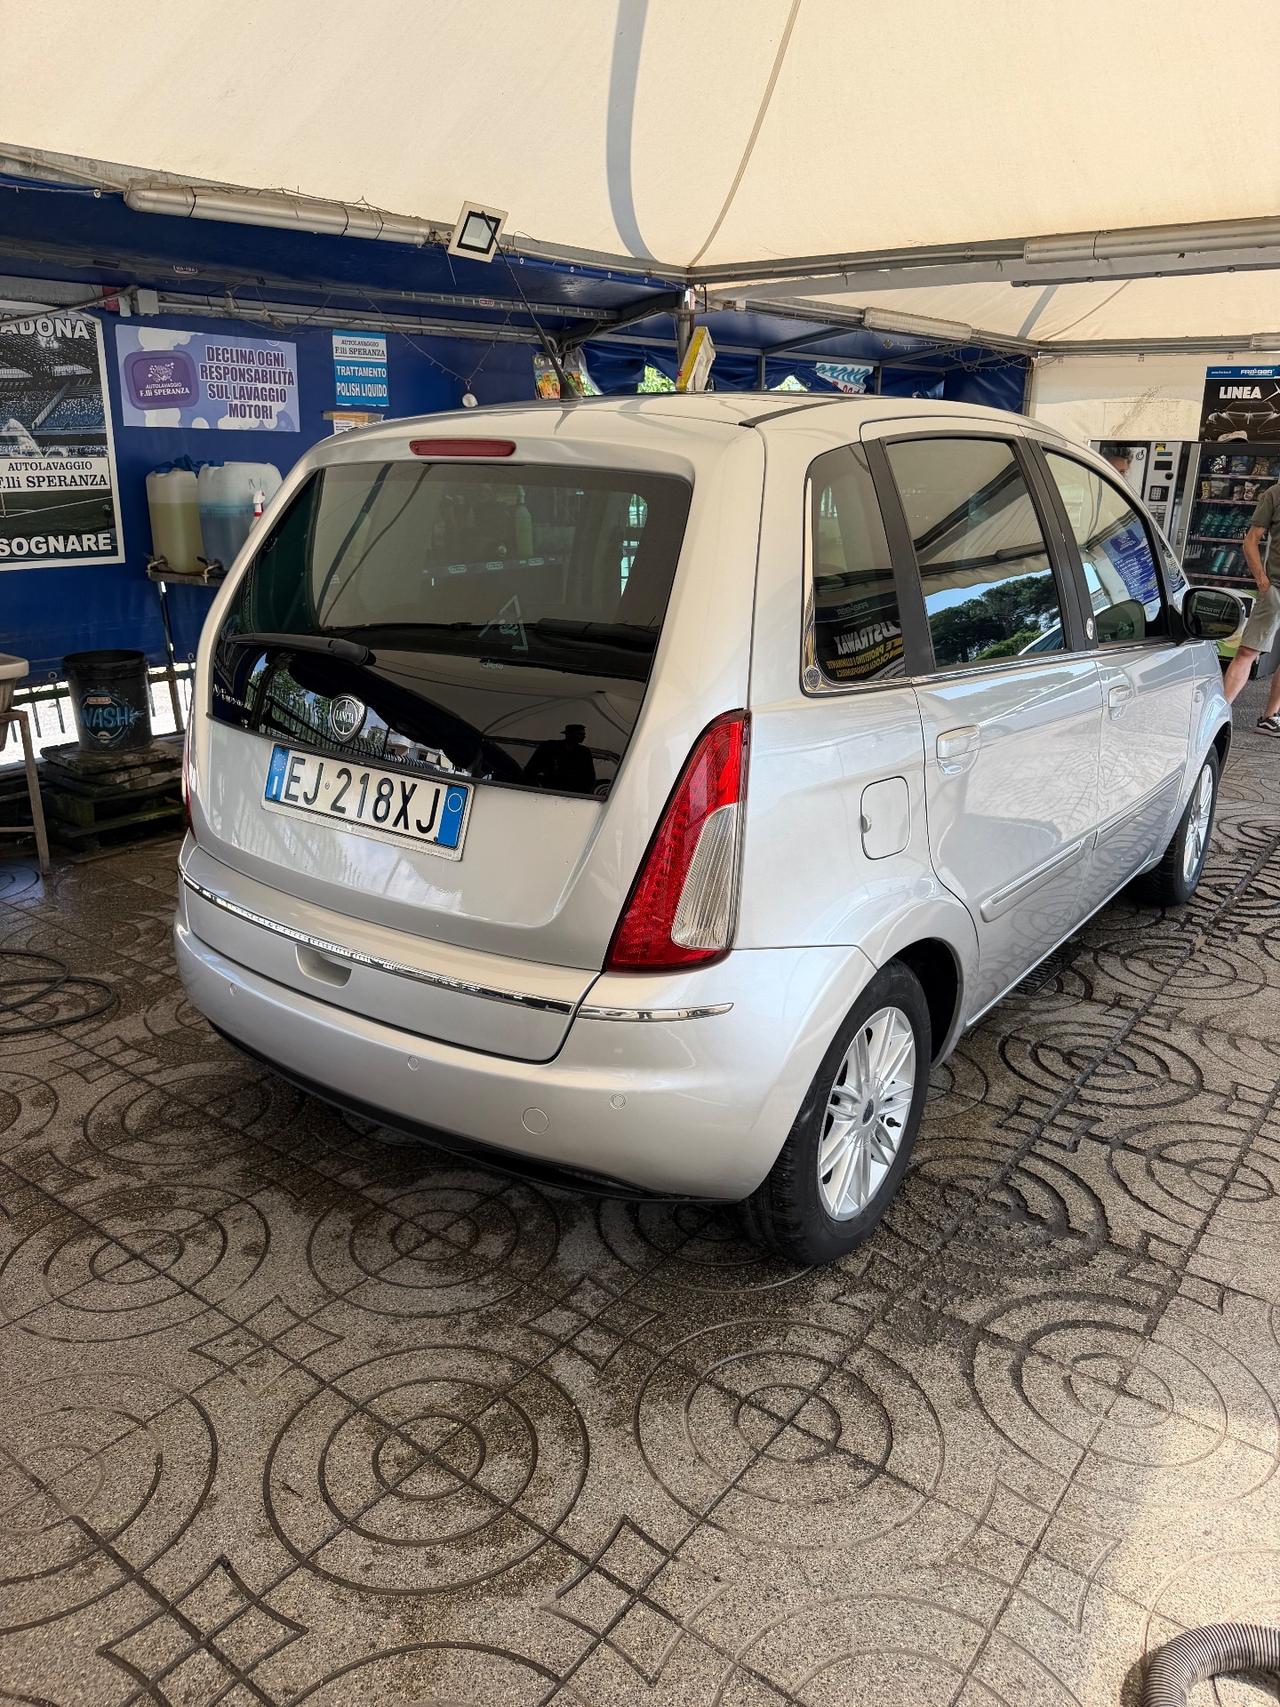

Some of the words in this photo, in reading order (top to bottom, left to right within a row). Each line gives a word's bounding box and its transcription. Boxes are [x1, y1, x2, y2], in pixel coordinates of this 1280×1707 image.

[206, 346, 256, 366] DECLINA
[257, 351, 285, 368] OGNI
[348, 347, 386, 357] SPERANZA
[200, 364, 295, 386] RESPONSABILITÀ
[336, 365, 387, 378] TRATTAMENTO
[153, 387, 190, 396] SPERANZA
[207, 382, 231, 400] SUL
[232, 385, 287, 403] LAVAGGIO
[336, 382, 360, 397] POLISH
[361, 383, 388, 397] LIQUIDO
[1219, 386, 1262, 399] LINEA
[228, 403, 273, 420] MOTORI
[8, 461, 93, 472] AUTOLAVAGGIO
[26, 474, 108, 489] SPERANZA
[0, 533, 112, 557] SOGNARE
[81, 706, 129, 728] WASH
